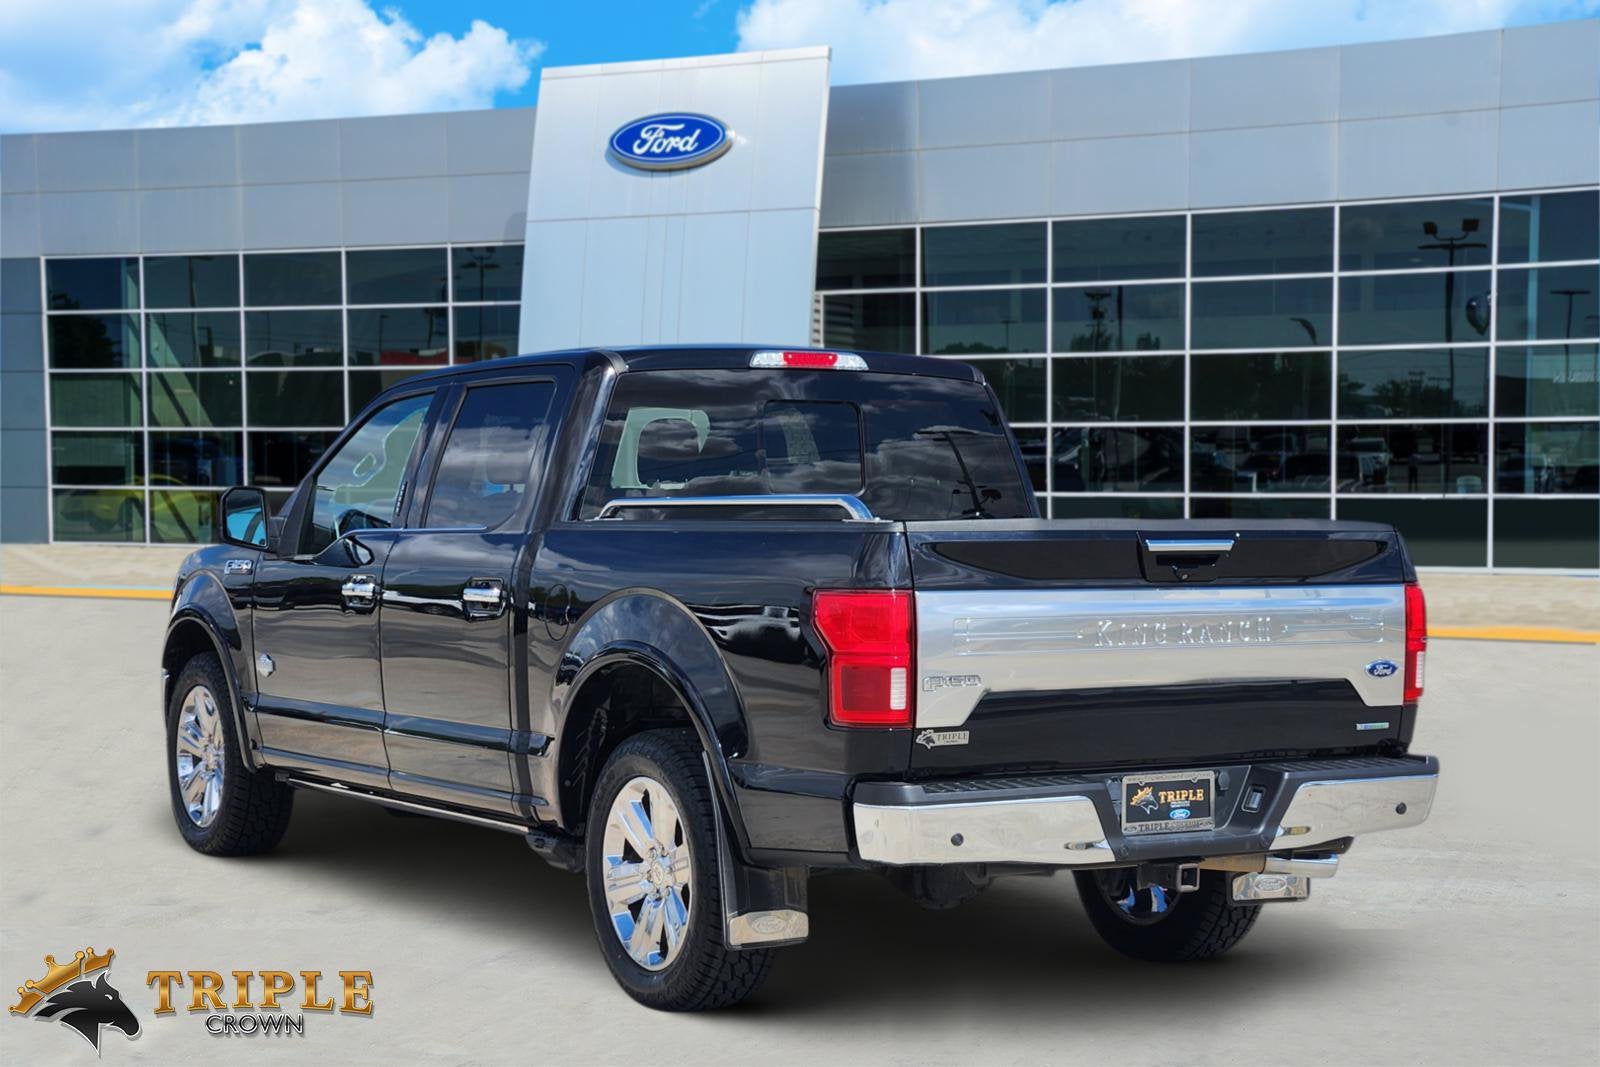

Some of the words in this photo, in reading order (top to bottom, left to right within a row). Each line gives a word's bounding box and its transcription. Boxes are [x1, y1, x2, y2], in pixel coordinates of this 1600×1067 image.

[632, 123, 702, 155] Ford
[1094, 619, 1168, 647] KING
[1176, 616, 1272, 644] RANCH
[937, 732, 968, 741] TRIPLE
[1158, 788, 1205, 804] TRIPLE
[1138, 820, 1169, 833] TRIPLE
